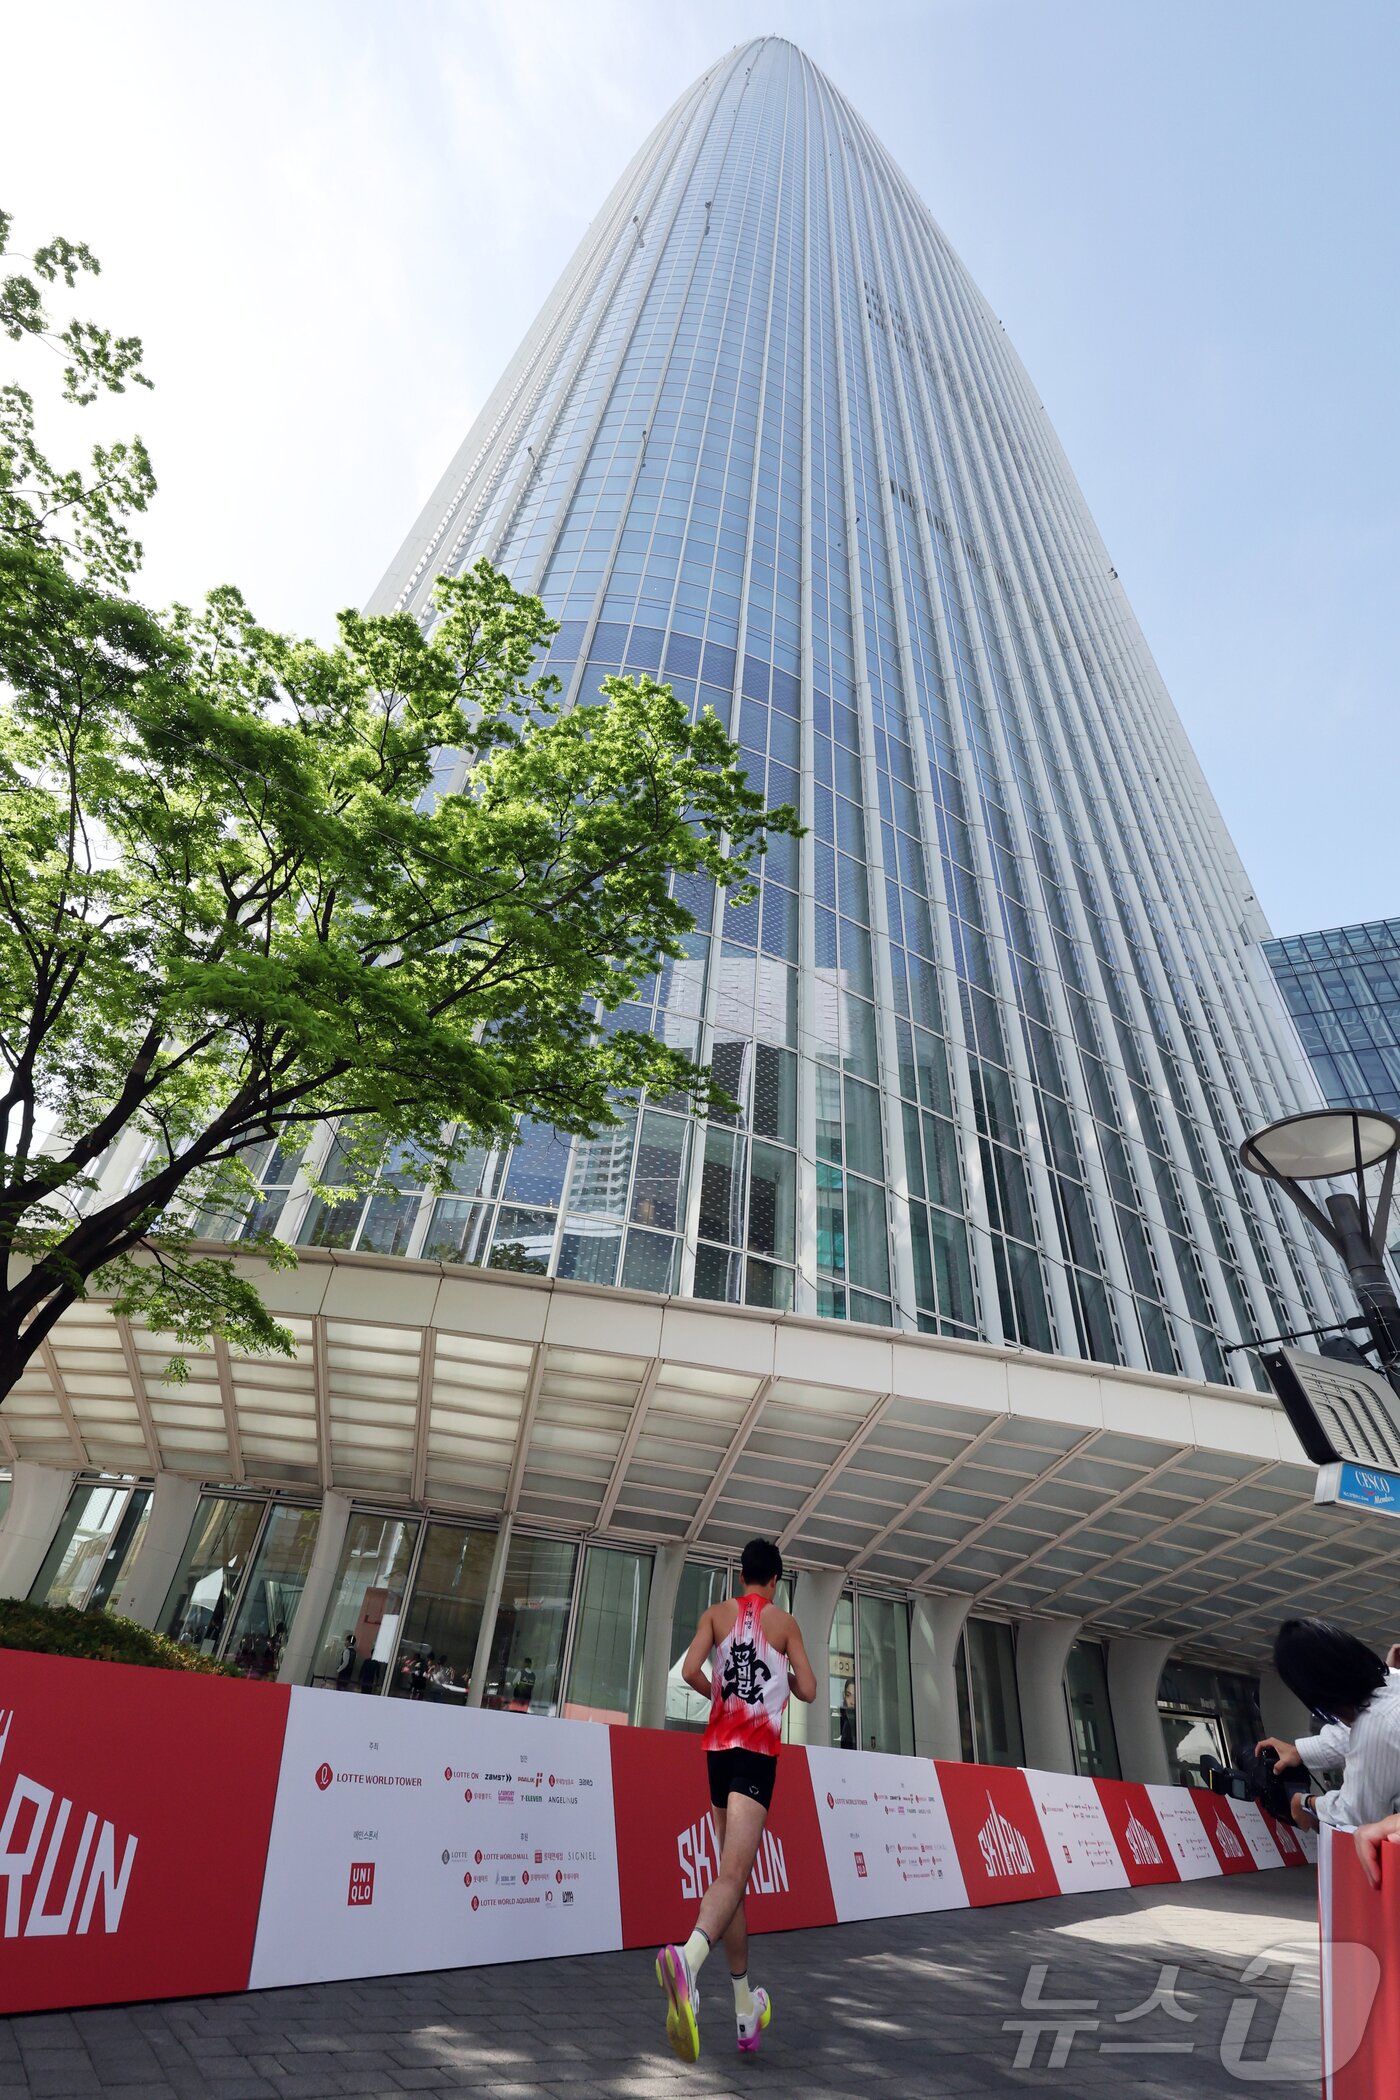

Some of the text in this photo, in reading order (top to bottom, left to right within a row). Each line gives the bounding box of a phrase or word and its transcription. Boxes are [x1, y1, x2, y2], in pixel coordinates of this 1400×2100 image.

[1355, 1471, 1390, 1494] CESCO
[336, 1773, 423, 1787] LOTTE WORLD TOWER
[0, 1773, 138, 1938] RUN
[567, 1851, 597, 1861] SIGNIEL
[745, 1828, 790, 1895] UN
[353, 1868, 371, 1882] UNI
[351, 1885, 371, 1903] QLO
[480, 1897, 497, 1906] LOTTE
[497, 1896, 516, 1905] WORLD
